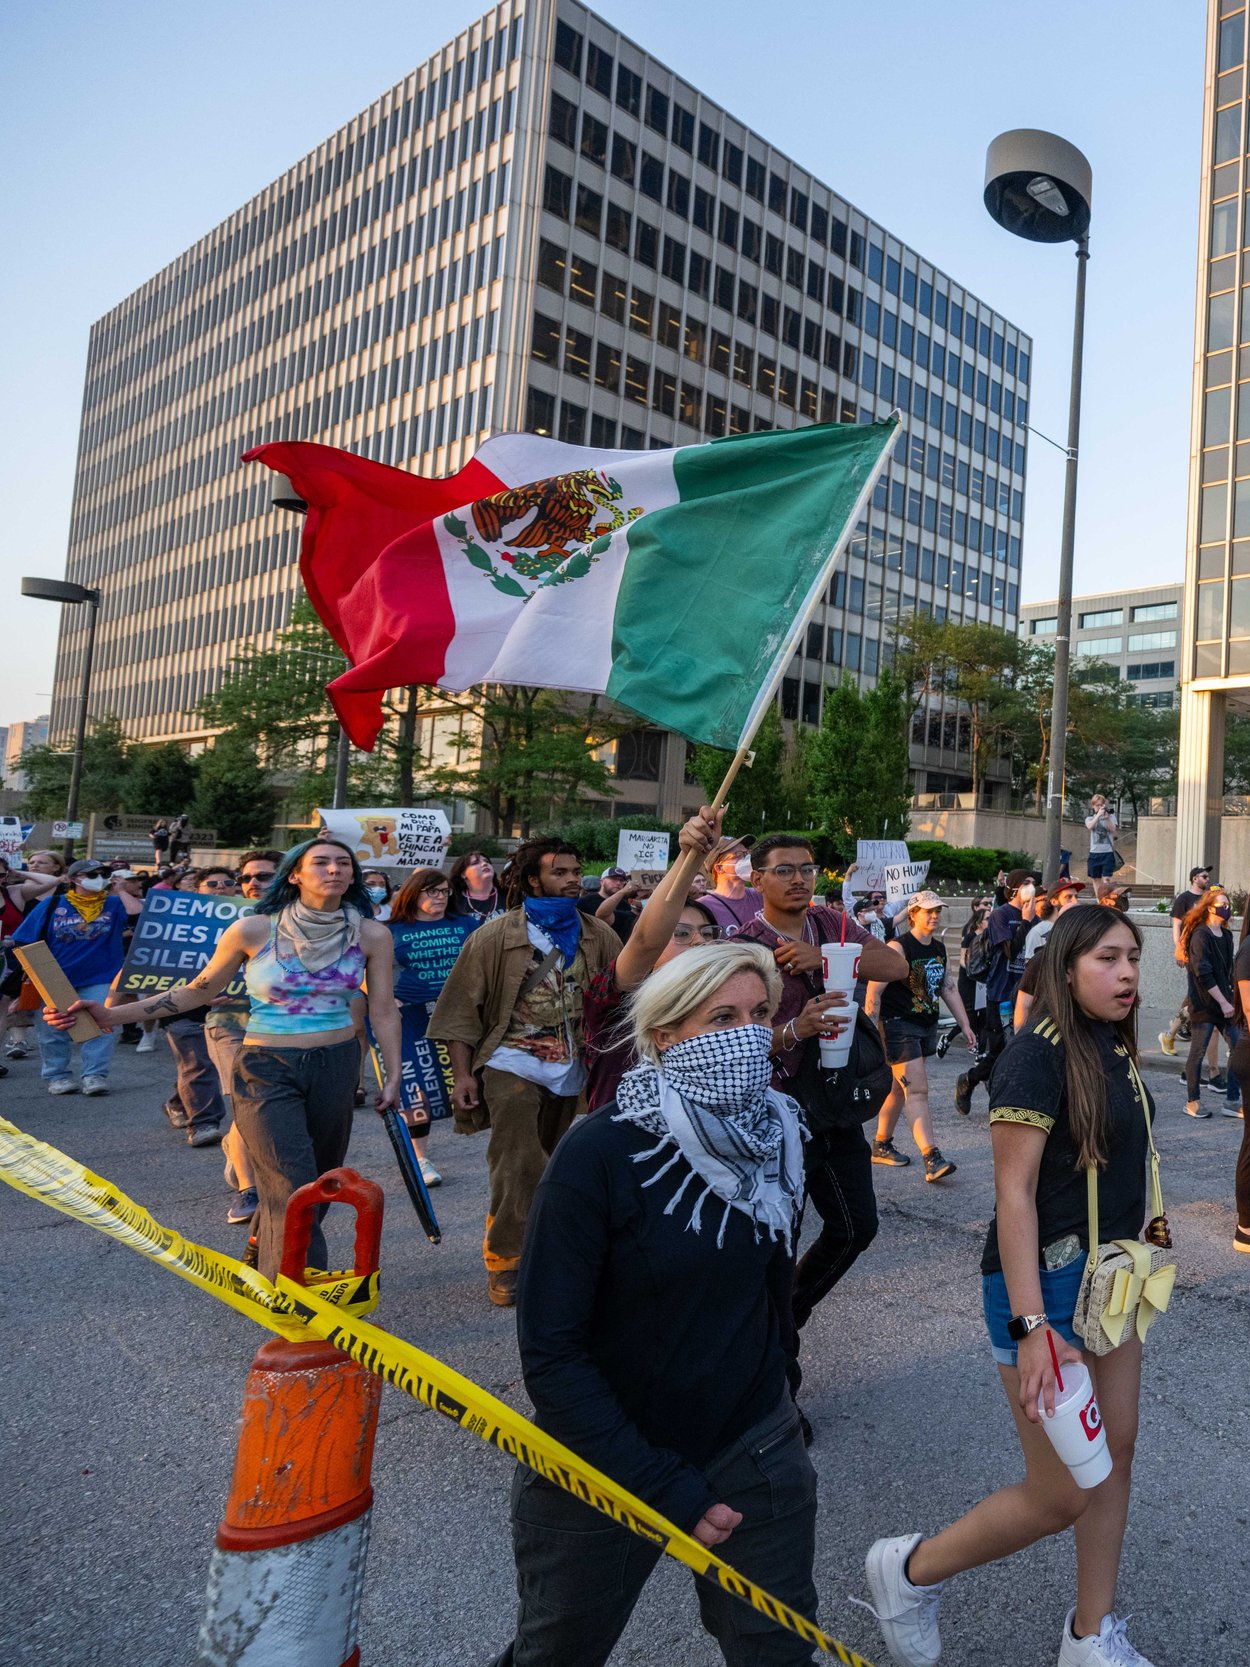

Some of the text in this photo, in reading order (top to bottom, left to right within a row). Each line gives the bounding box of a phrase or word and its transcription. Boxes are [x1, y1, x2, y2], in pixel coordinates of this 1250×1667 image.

[401, 812, 437, 821] COMO
[411, 819, 436, 827] DICE
[401, 823, 441, 834] MI PAPA
[398, 832, 443, 845] VETE A
[629, 833, 668, 845] MARGARITA
[398, 842, 444, 854] CHINCAR
[402, 850, 416, 858] TU
[396, 858, 440, 867] MADRE!
[886, 867, 900, 882] NO
[890, 882, 921, 896] IS ILLE
[148, 895, 254, 921] DEMOC
[140, 921, 209, 944] DIES
[402, 926, 465, 942] CHANGE IS
[411, 936, 460, 949] COMING
[130, 947, 213, 970] SILEN
[418, 968, 453, 980] OR NO
[124, 973, 188, 992] SPEA
[435, 1041, 450, 1065] OU
[402, 1060, 417, 1080] IN
[414, 1039, 446, 1117] SILENCE!
[406, 1082, 428, 1122] DIES
